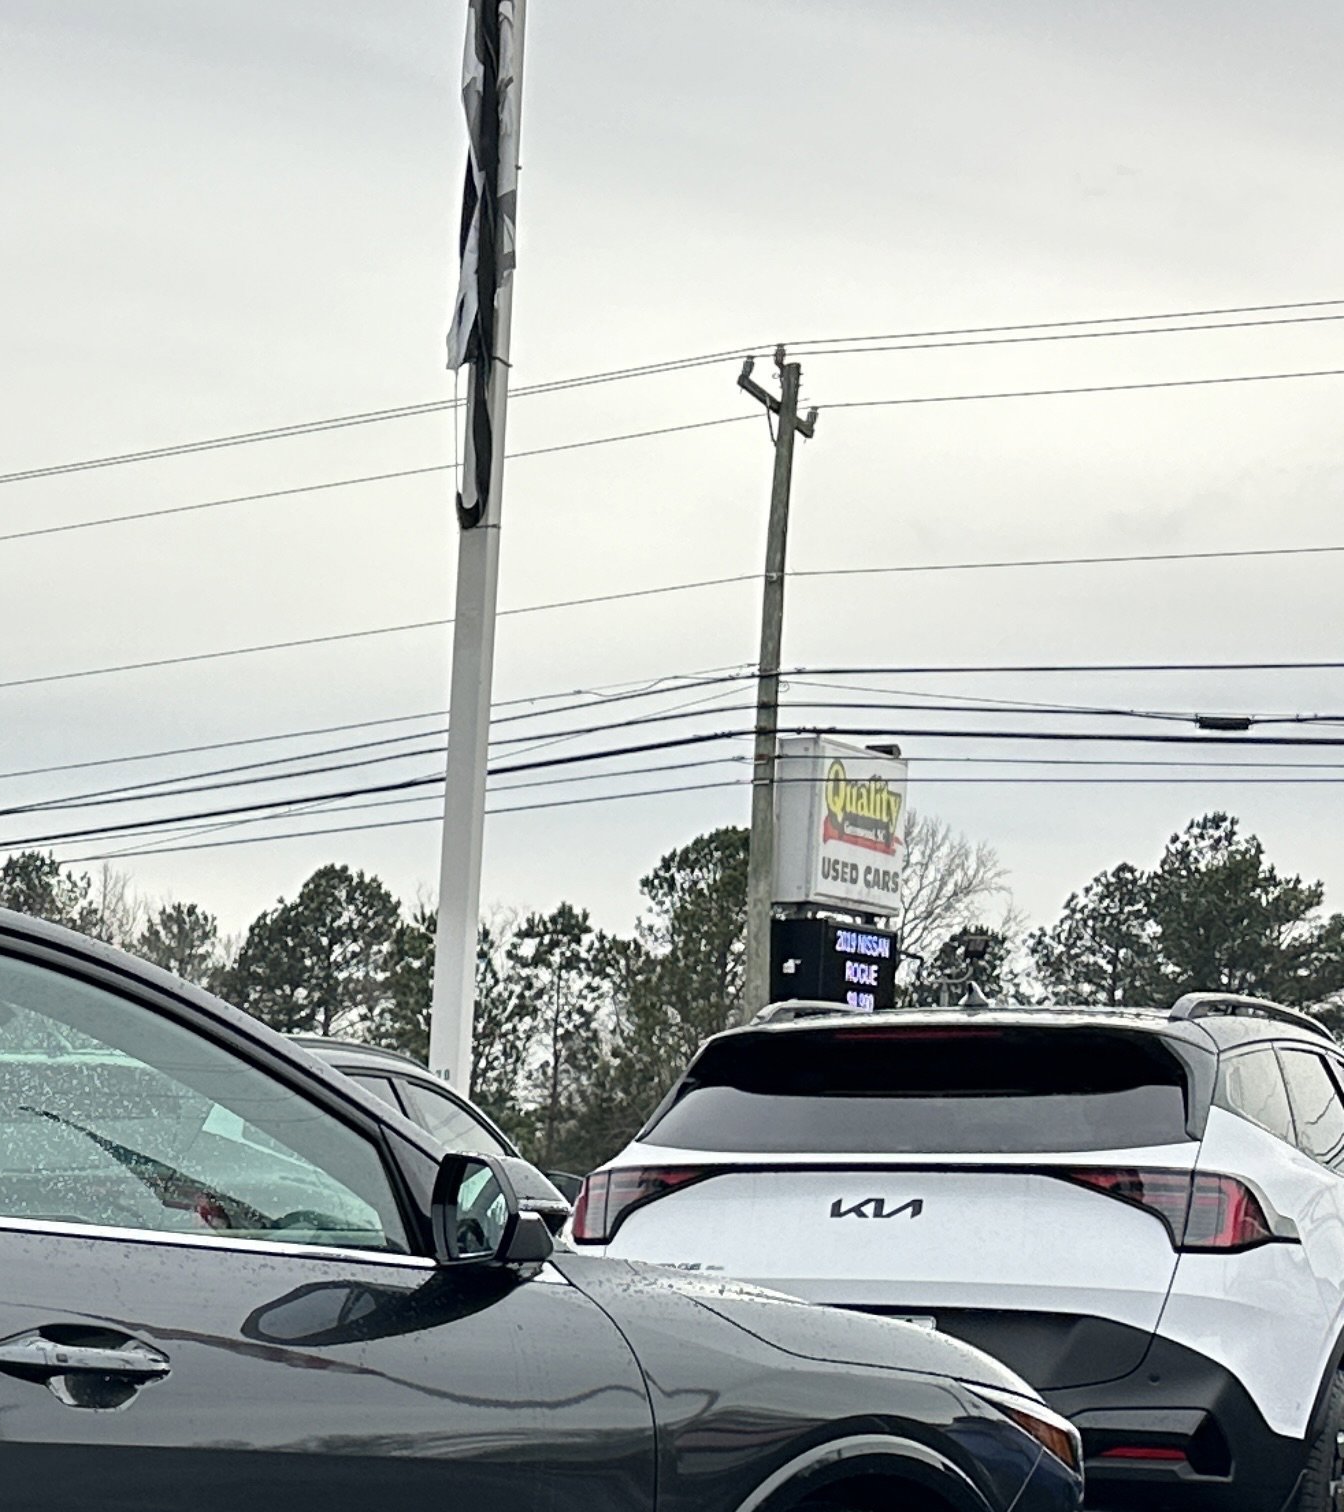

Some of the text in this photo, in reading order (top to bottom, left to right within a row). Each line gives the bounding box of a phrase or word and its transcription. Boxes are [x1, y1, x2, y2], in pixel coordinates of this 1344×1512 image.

[826, 759, 902, 834] Quality
[821, 856, 900, 893] USED CARS
[858, 934, 891, 958] NISSAN
[845, 960, 879, 986] ROGUE
[830, 1198, 923, 1219] KIA
